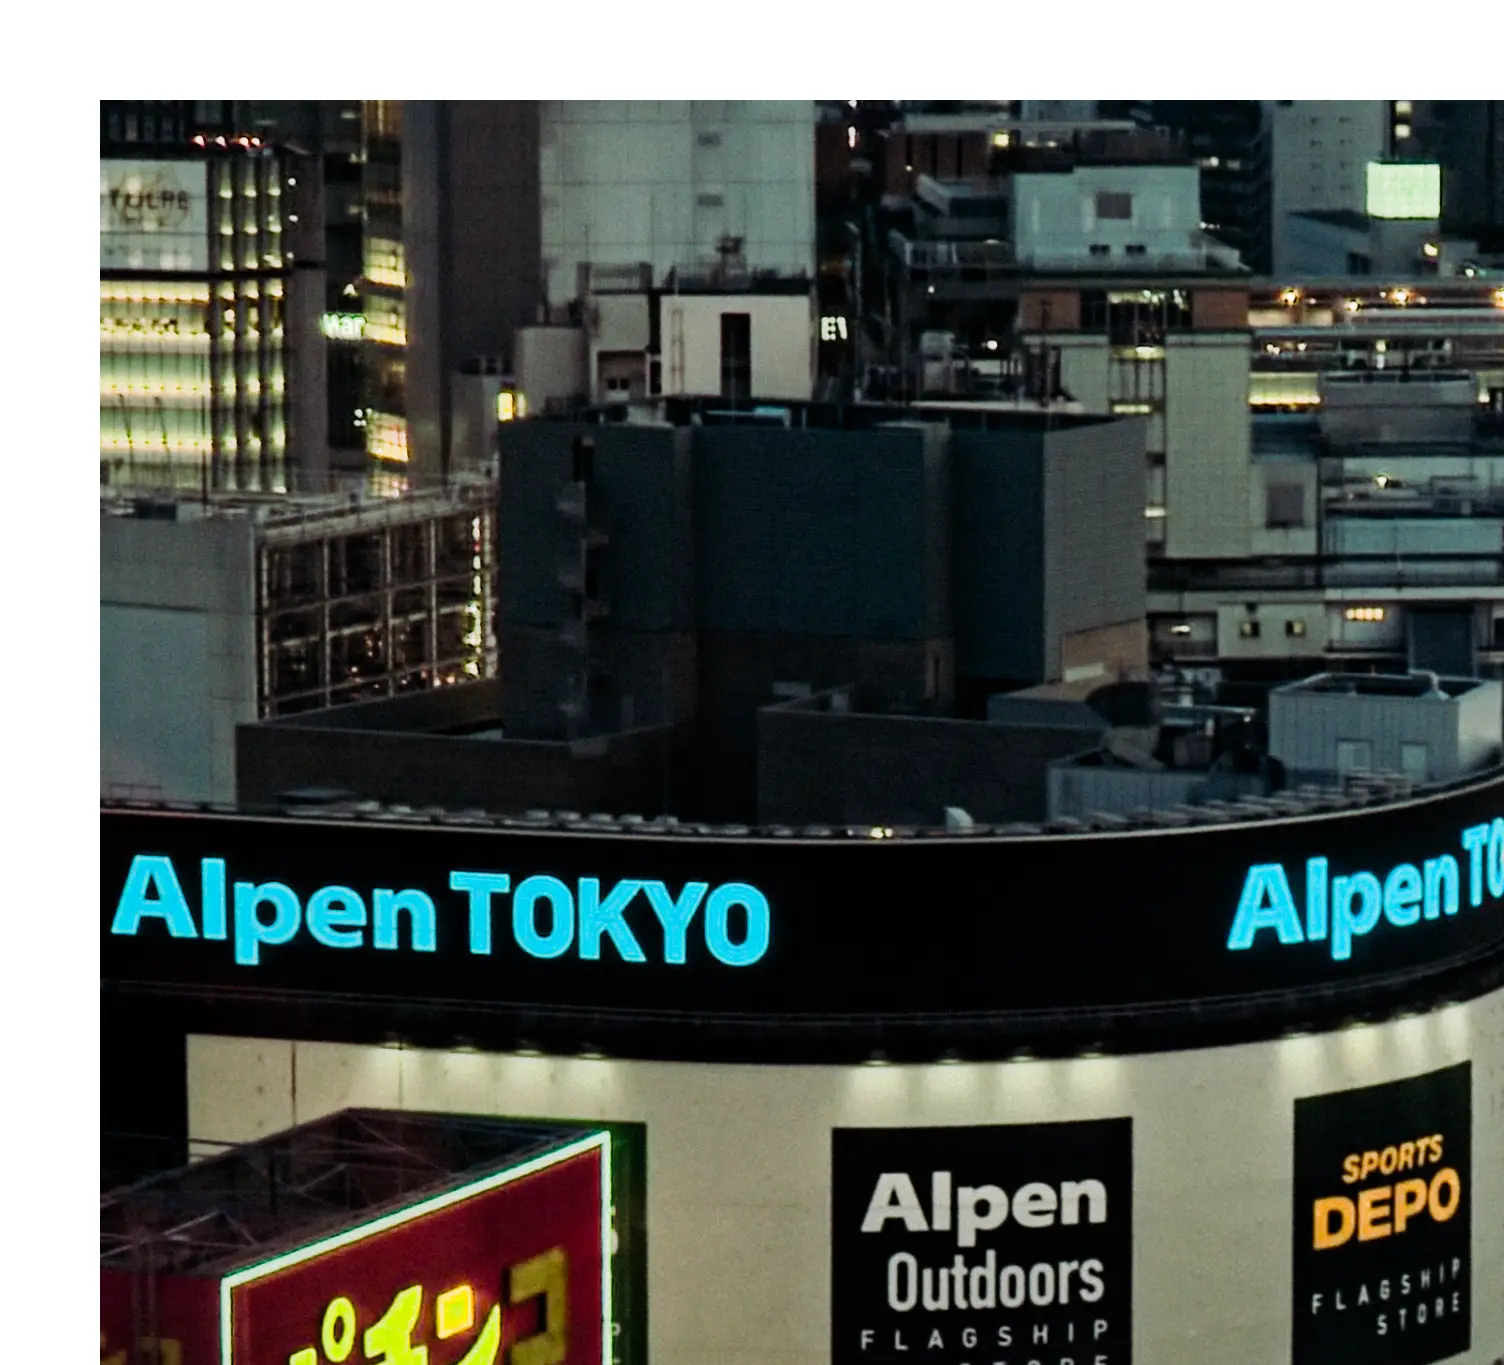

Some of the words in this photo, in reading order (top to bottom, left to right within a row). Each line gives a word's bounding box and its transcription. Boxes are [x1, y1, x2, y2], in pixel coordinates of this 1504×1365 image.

[111, 855, 437, 965] Alpen
[450, 870, 771, 967] TOKYO
[1226, 853, 1460, 960] Alpen
[1341, 1133, 1443, 1184] SPORTS
[860, 1171, 1107, 1247] Alpen
[1313, 1167, 1461, 1250] DEPO
[887, 1249, 1105, 1312] Outdoors
[1311, 1257, 1460, 1315] FLAGSHIP
[860, 1318, 1109, 1351] FLAGSHIP
[1376, 1296, 1460, 1336] STORE
